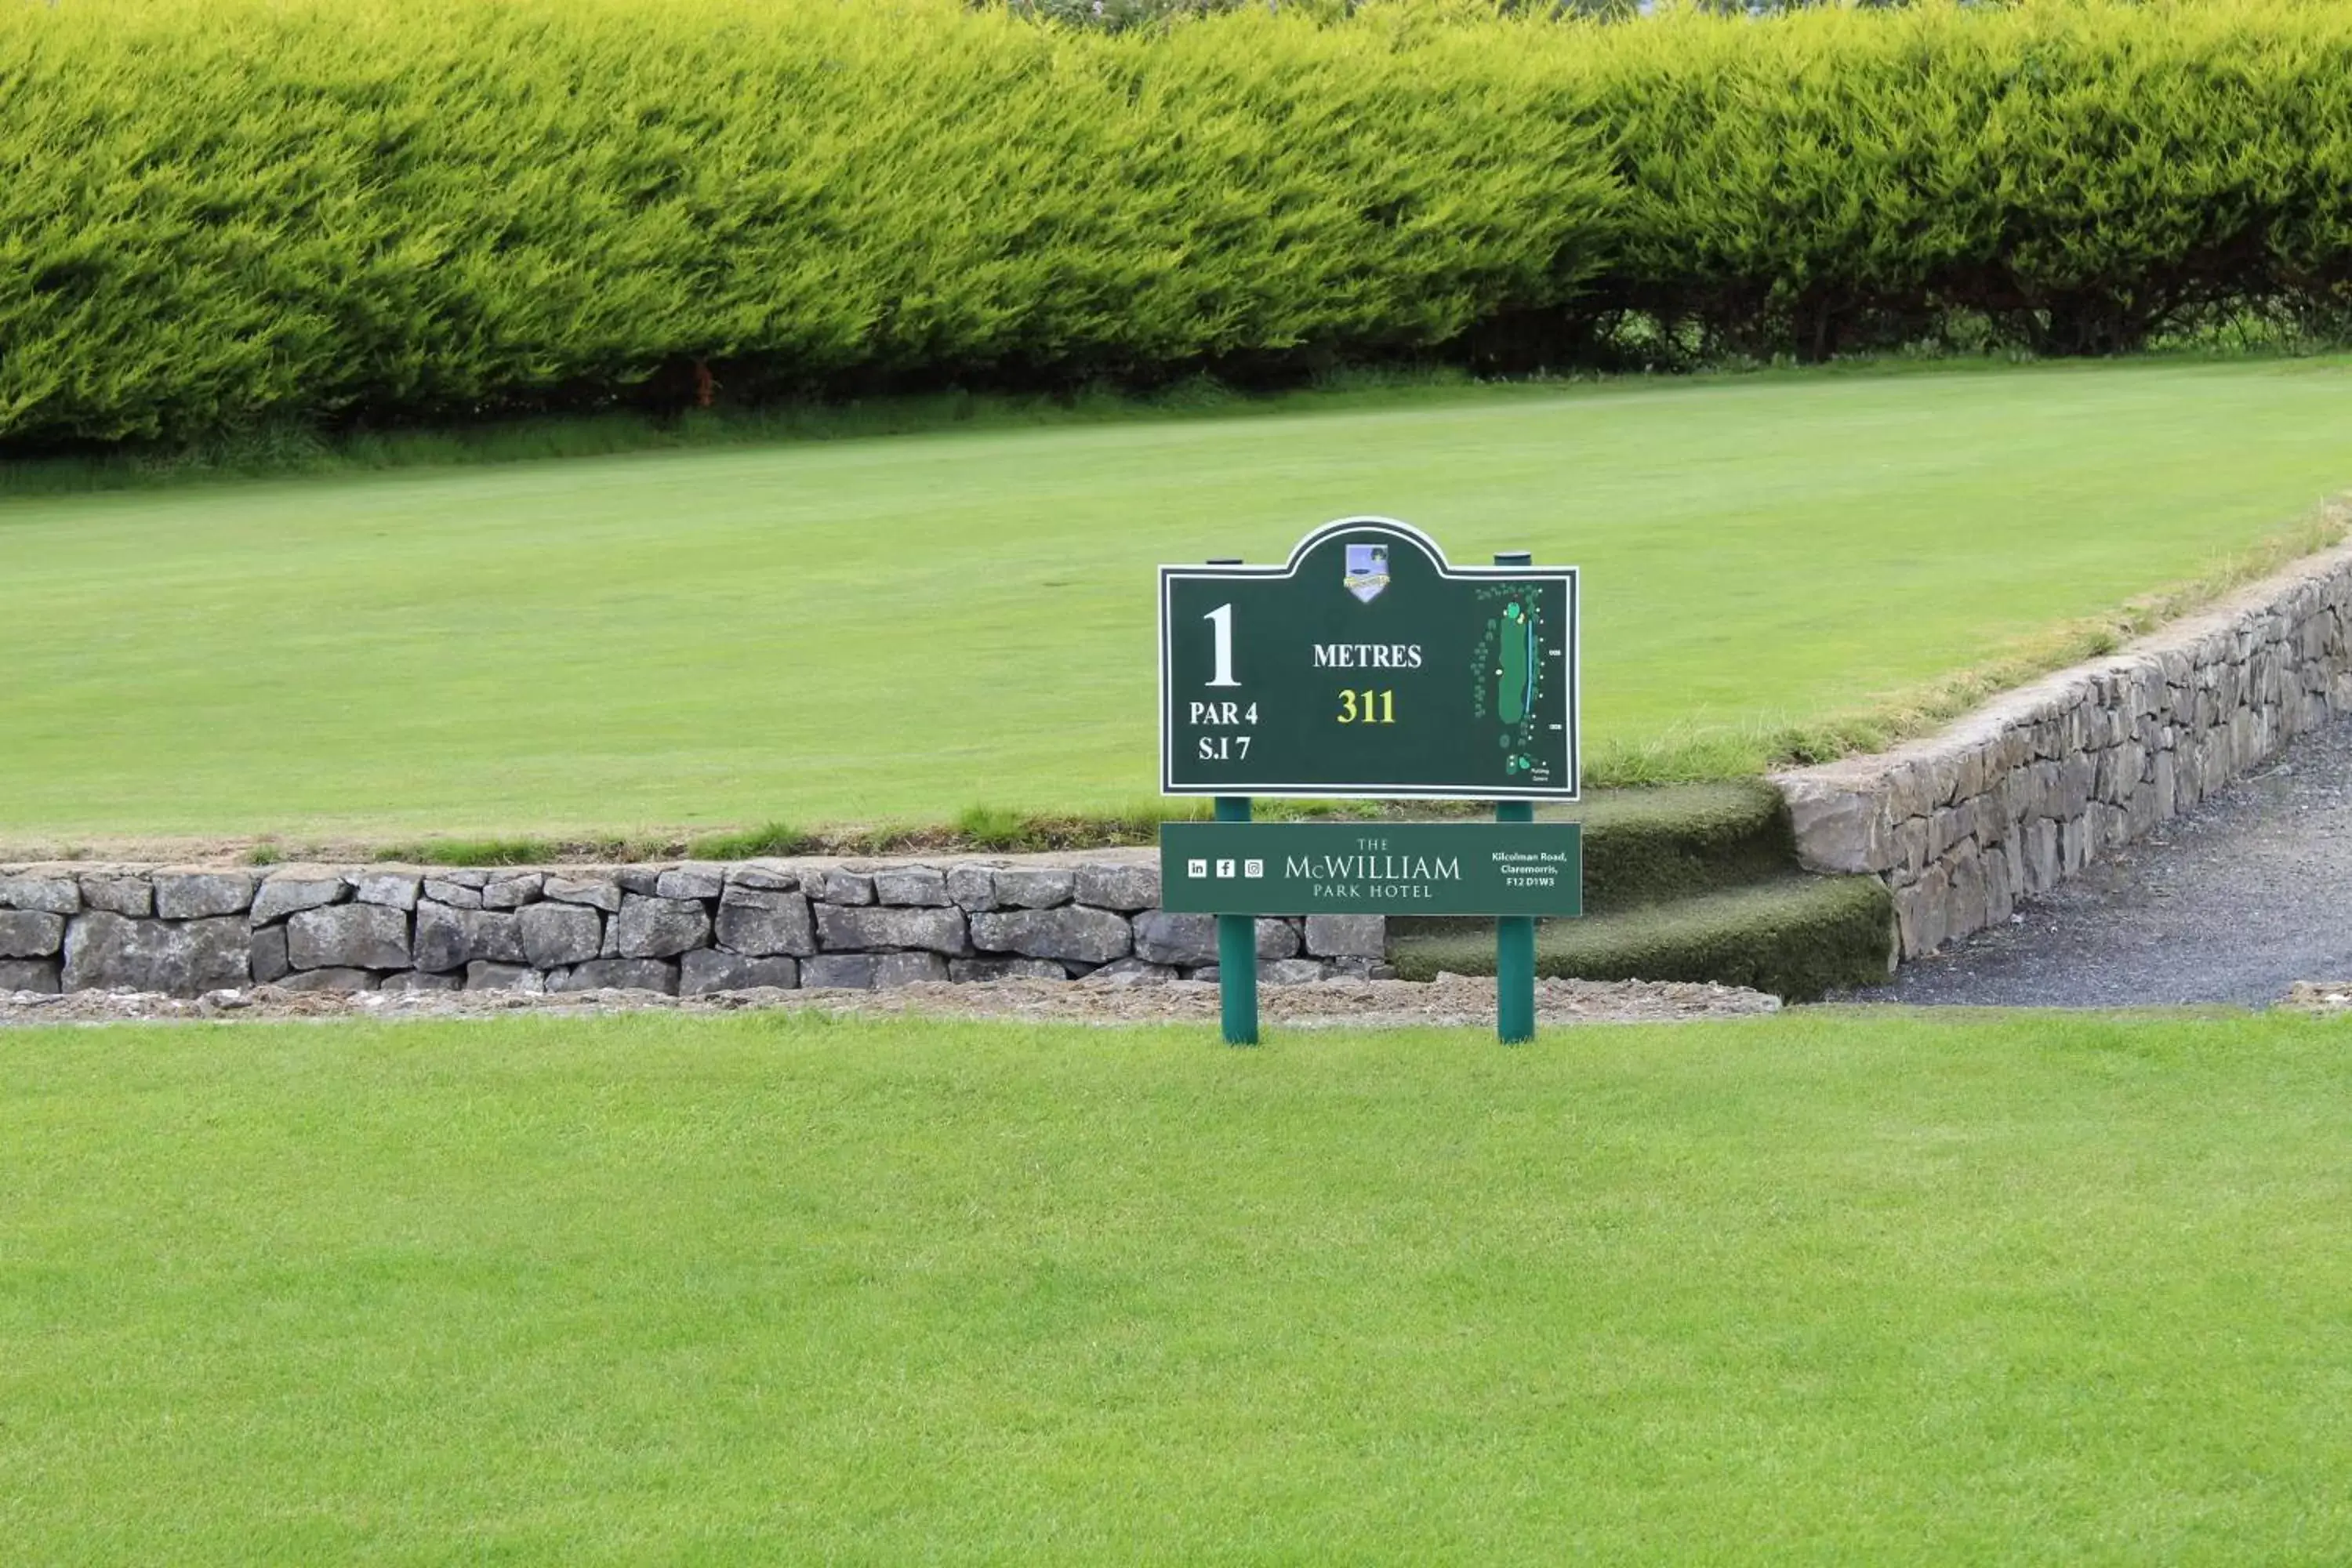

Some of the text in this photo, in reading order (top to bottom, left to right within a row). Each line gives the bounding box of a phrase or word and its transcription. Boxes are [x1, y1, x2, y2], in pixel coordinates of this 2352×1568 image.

[1203, 603, 1242, 687] 1
[1313, 644, 1422, 669] METRES
[1189, 702, 1258, 725] PAR 4
[1337, 689, 1396, 724] 311
[1199, 736, 1251, 760] S.I 7
[1357, 838, 1388, 851] THE
[1492, 851, 1567, 862] Kilcolman Road,
[1313, 884, 1432, 898] PARK HOTEL
